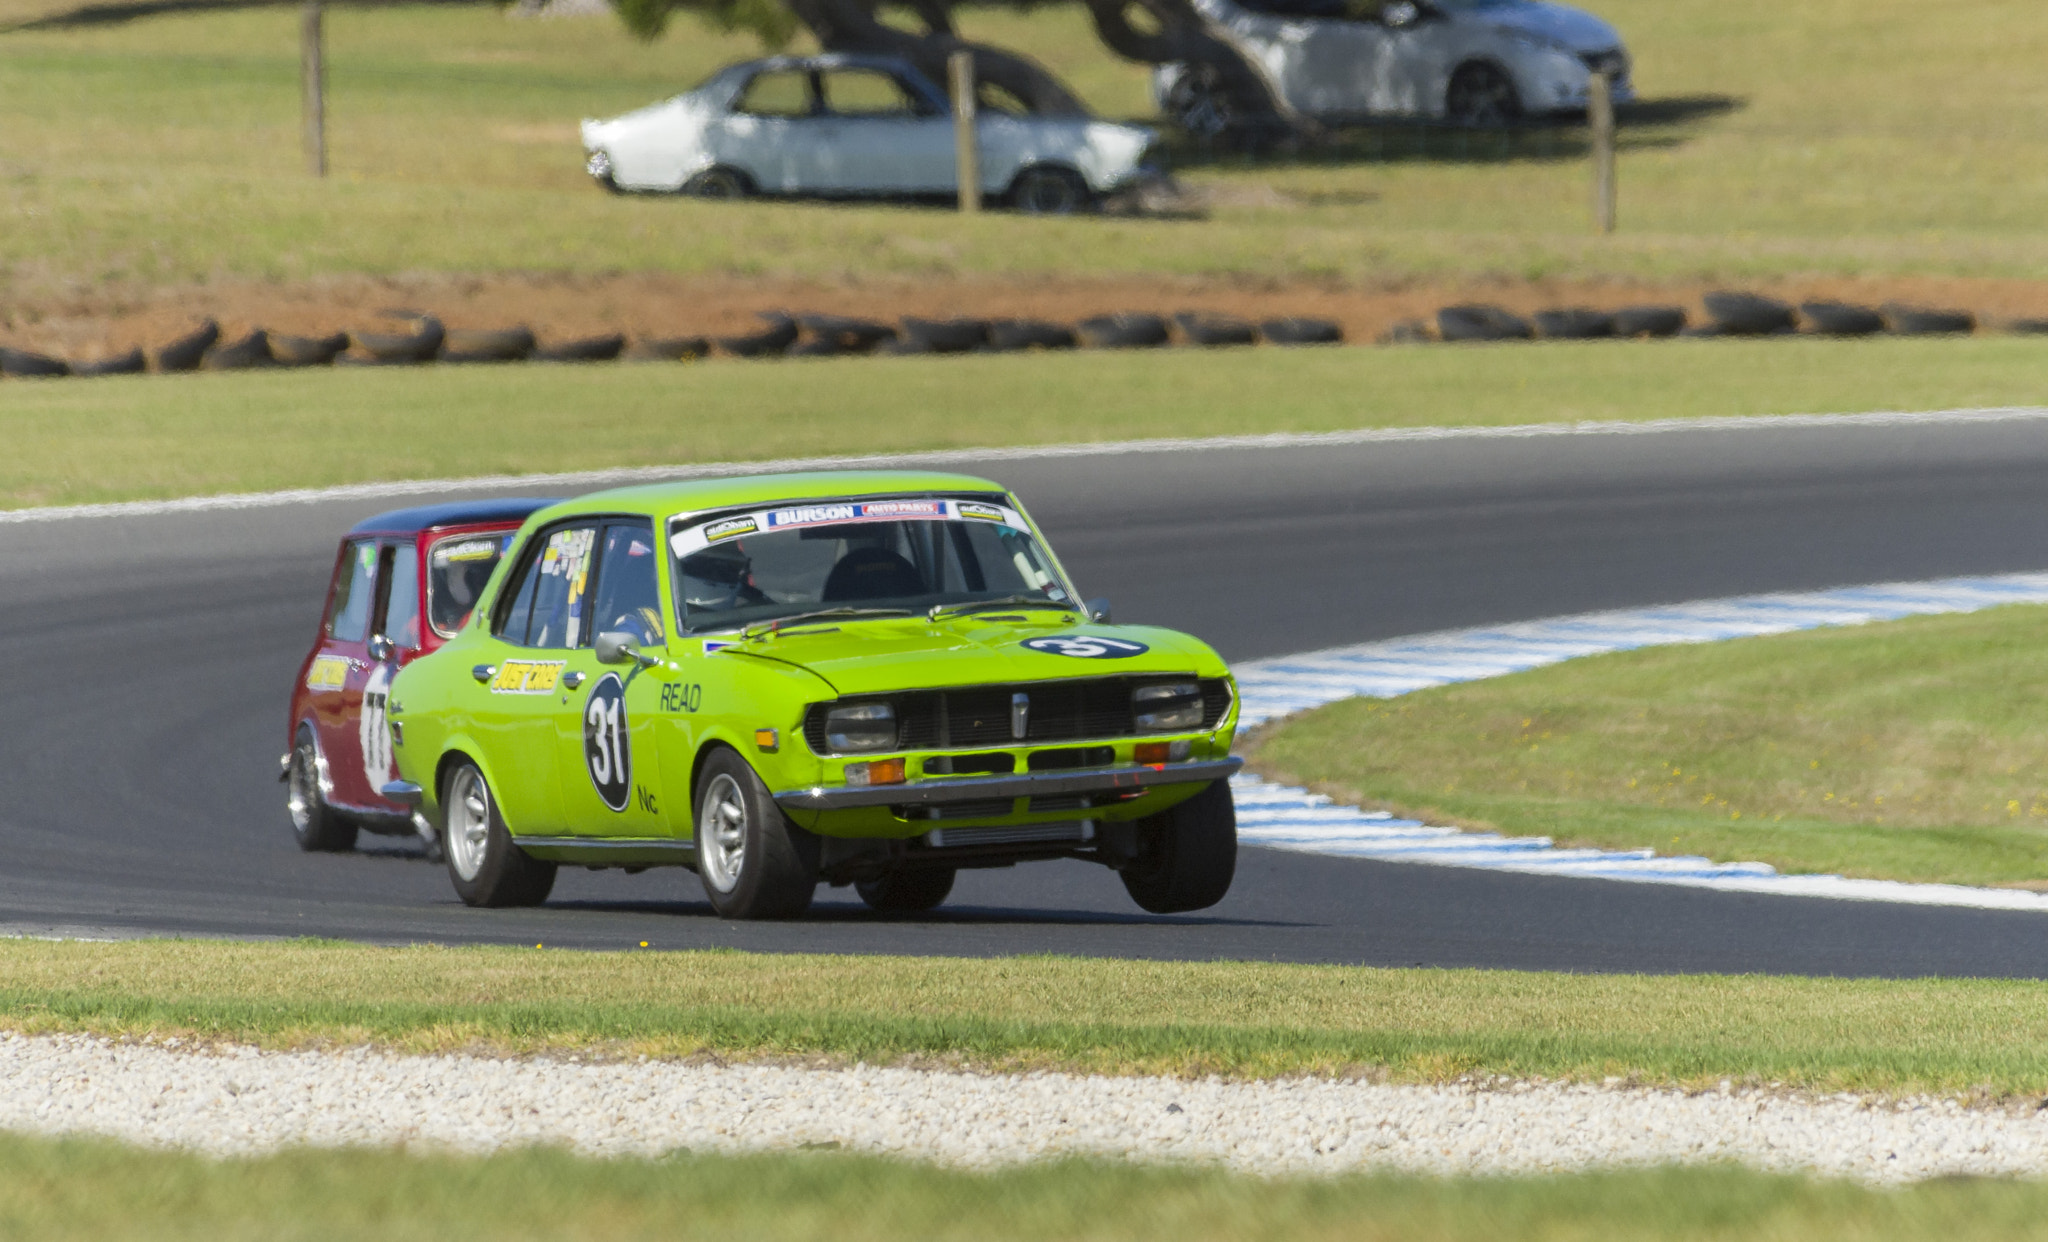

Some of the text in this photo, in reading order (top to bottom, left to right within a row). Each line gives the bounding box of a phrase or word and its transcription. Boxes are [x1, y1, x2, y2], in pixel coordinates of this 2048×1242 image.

[775, 502, 934, 525] BURSON AUTO PARTS
[1029, 635, 1141, 657] 31
[660, 683, 702, 713] READ
[588, 696, 625, 786] 31
